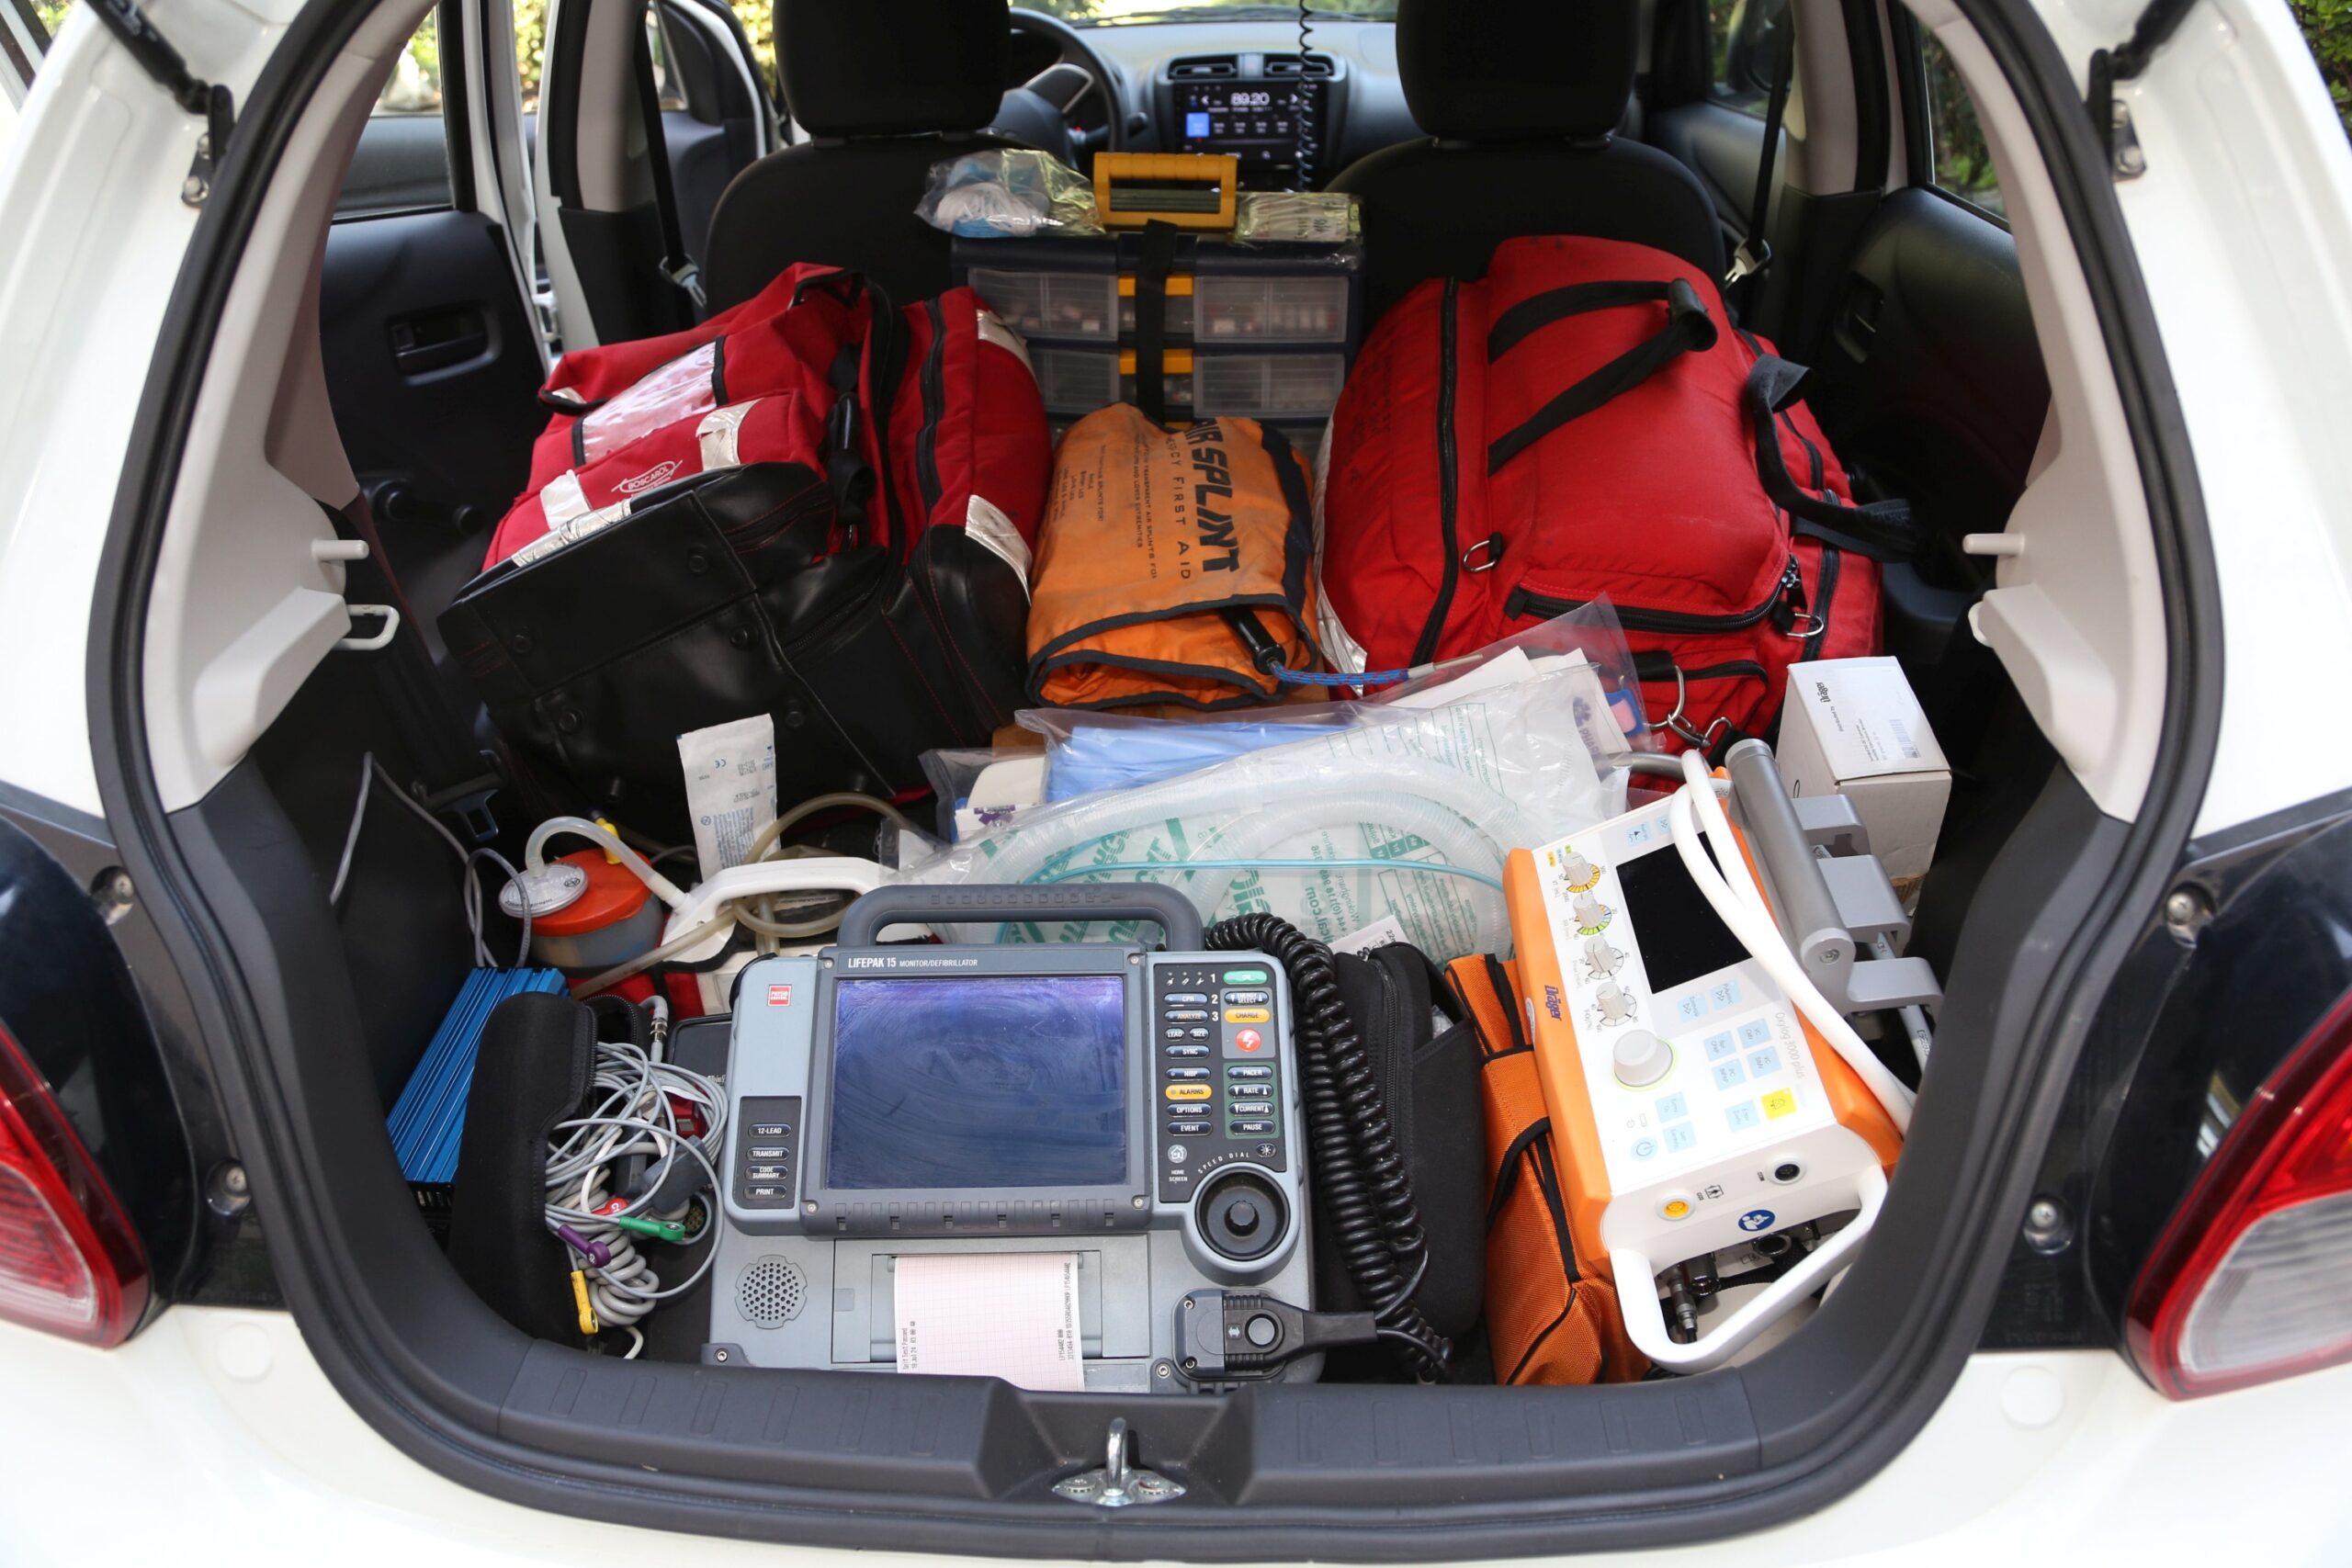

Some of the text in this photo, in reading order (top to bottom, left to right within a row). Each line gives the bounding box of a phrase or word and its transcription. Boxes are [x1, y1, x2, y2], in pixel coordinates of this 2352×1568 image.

[628, 465, 669, 490] BOSCAROL
[1143, 465, 1151, 508] TRANSPARENT
[1172, 476, 1186, 525] FIRST
[1192, 447, 1240, 572] SPLINT
[1135, 502, 1144, 548] EXTREMITIES
[1146, 525, 1155, 559] SPLINTS
[1177, 541, 1192, 580] AID
[1815, 682, 1831, 703] Dräger
[848, 957, 978, 968] LIFEPAK 15 MONITOR/DEFIBRILLATOR
[1210, 974, 1216, 983] 1
[1211, 994, 1218, 1004] 2
[1212, 1011, 1218, 1021] 3
[1544, 985, 1563, 1021] Dräger
[1775, 1012, 1806, 1079] Oxylog 3000 plus
[1197, 1156, 1224, 1174] SPEED
